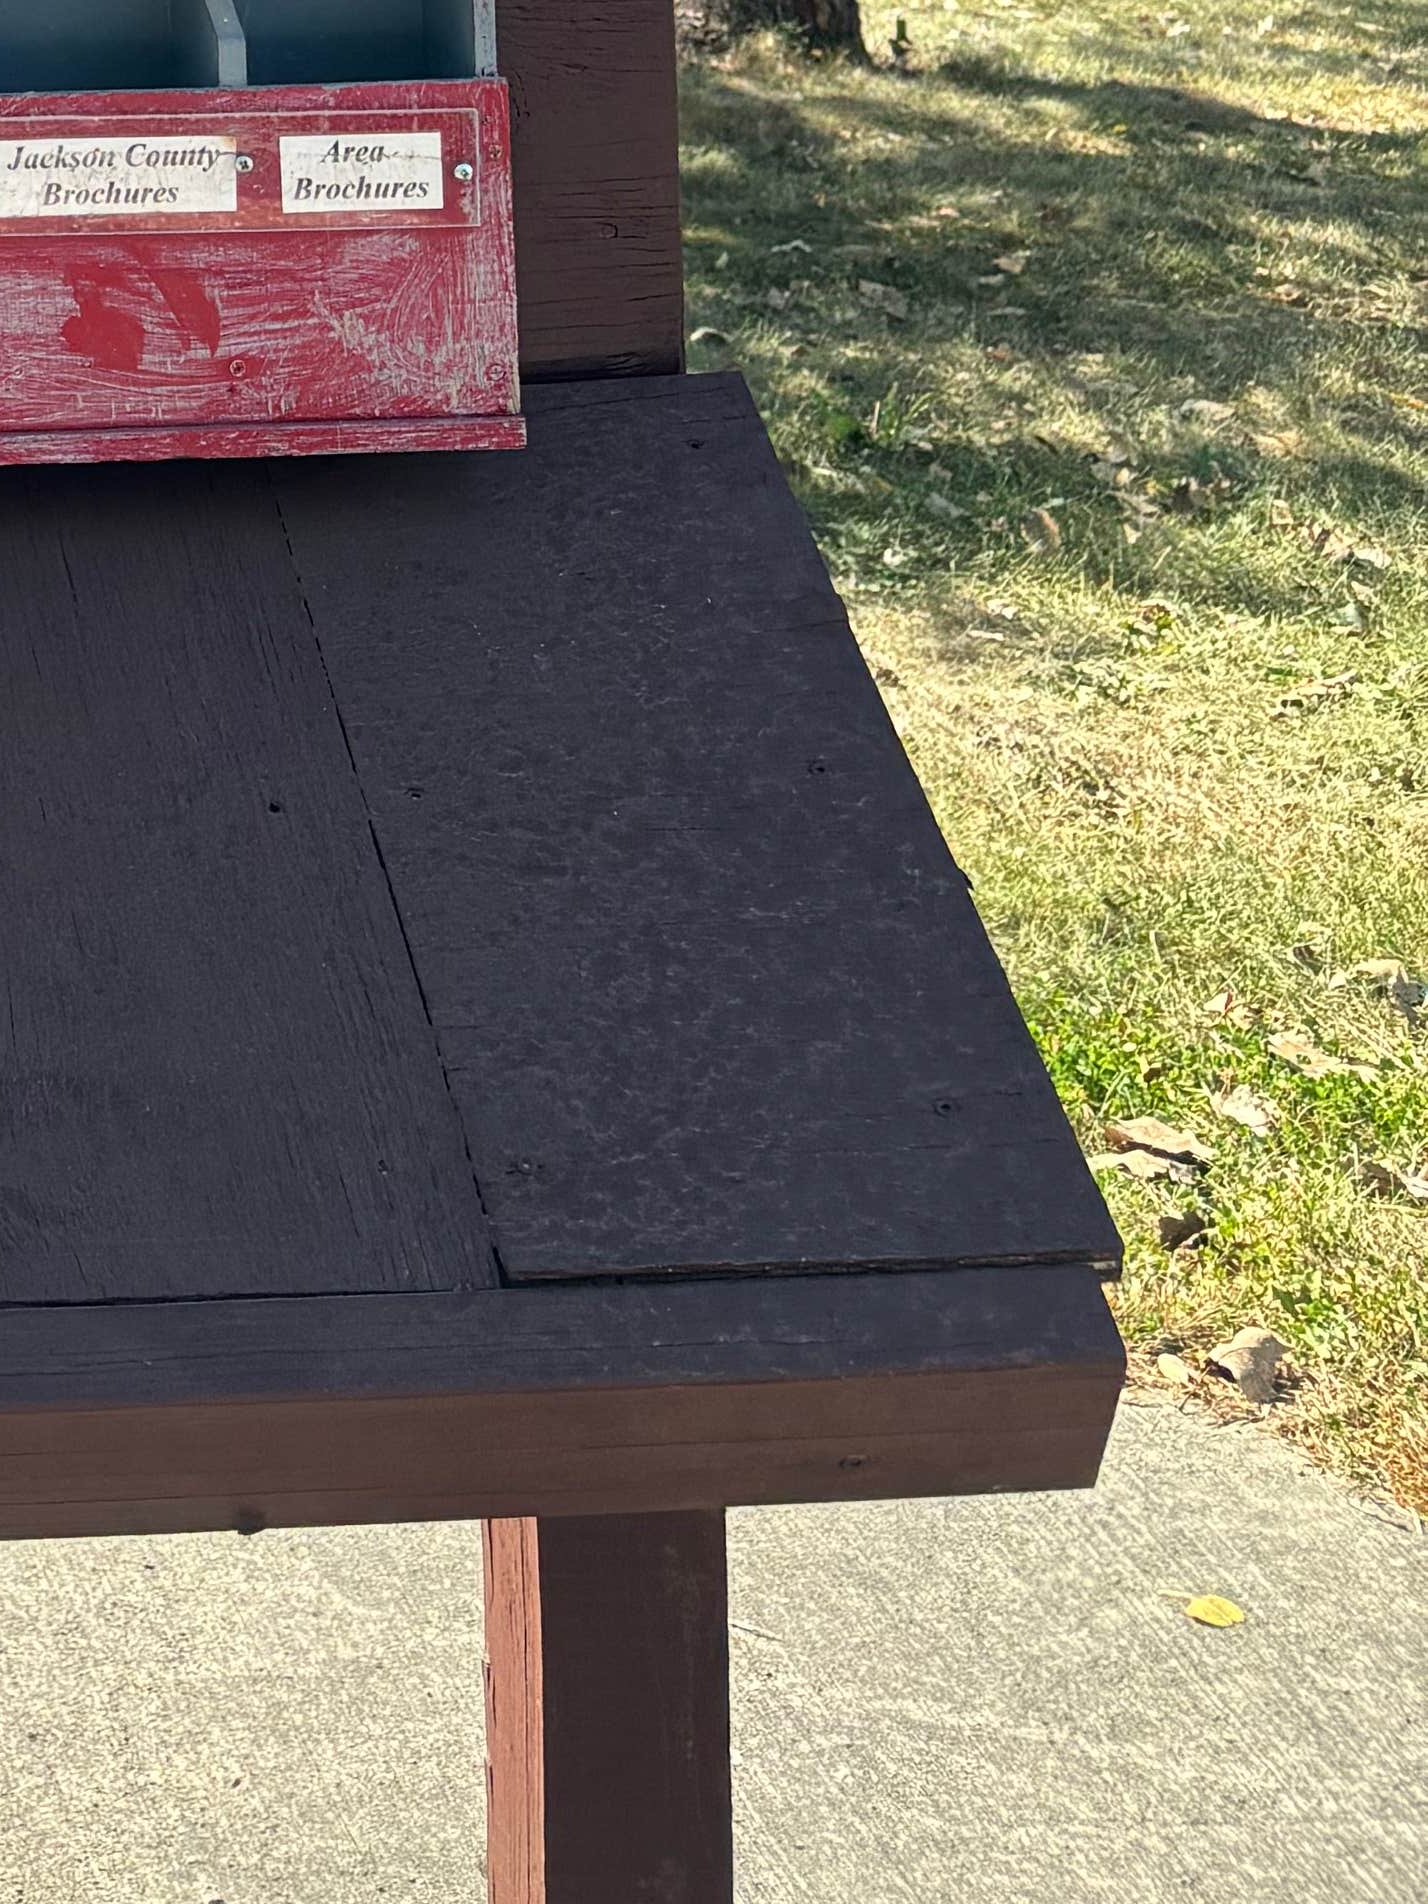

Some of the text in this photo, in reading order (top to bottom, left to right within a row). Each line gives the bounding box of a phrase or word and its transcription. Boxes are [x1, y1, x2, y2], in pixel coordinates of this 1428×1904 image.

[7, 143, 220, 172] Jackson County
[320, 139, 387, 163] Area
[43, 181, 179, 206] Brochures
[294, 176, 429, 200] Brochures
